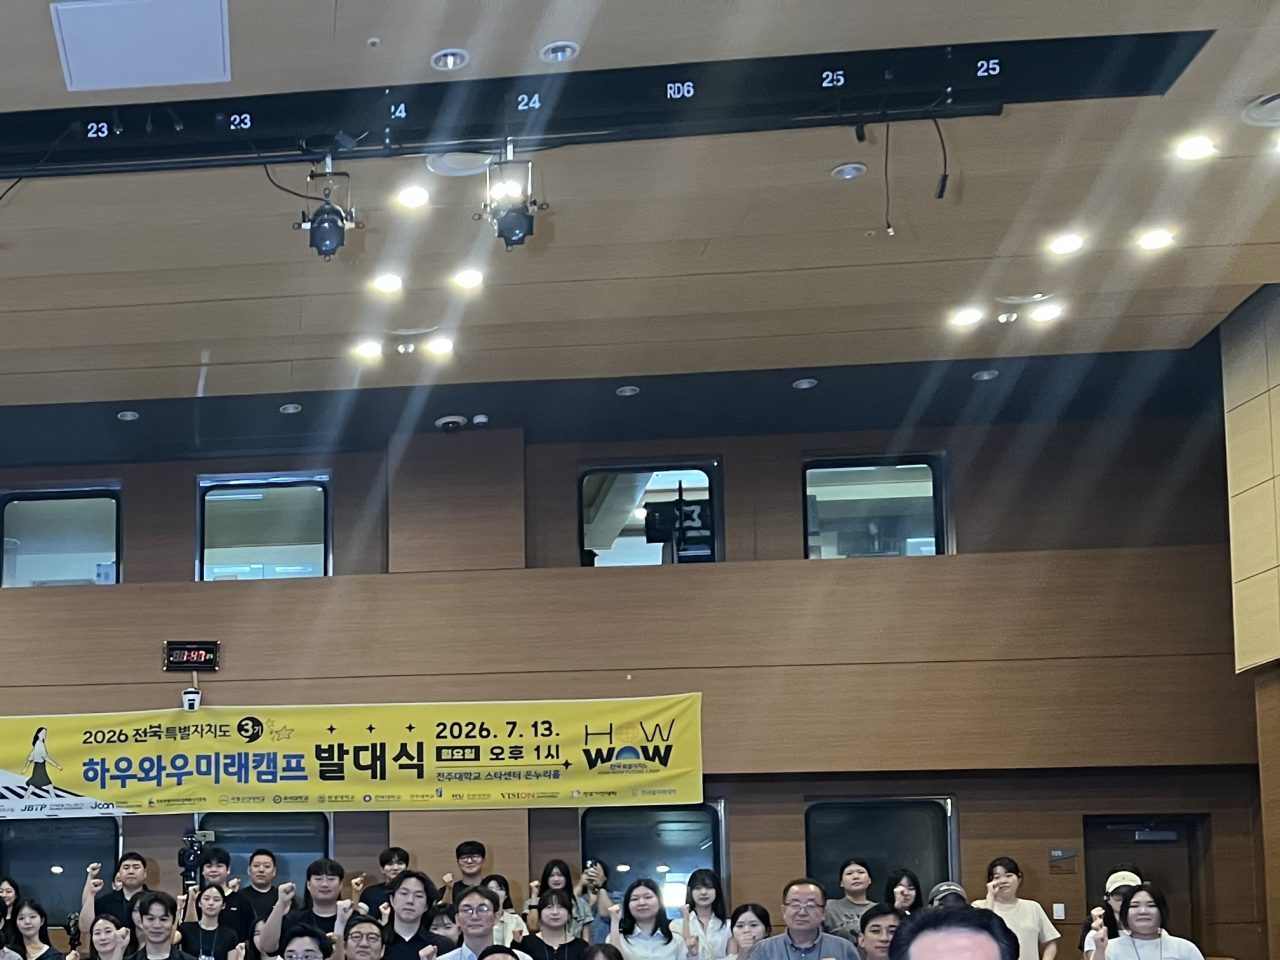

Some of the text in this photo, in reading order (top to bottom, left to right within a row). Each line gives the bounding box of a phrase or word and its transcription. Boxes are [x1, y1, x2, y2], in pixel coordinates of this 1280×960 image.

[977, 59, 1000, 77] 25
[822, 70, 845, 87] 25
[666, 81, 695, 99] RD6
[517, 93, 541, 111] 24
[87, 122, 109, 138] 23
[230, 113, 251, 130] 23
[82, 729, 129, 745] 2026
[132, 723, 232, 743] 전북특별자치도
[435, 720, 560, 740] 2026. 7. 13.
[489, 745, 524, 761] 오후
[533, 744, 560, 761] 1시
[82, 741, 425, 790] 하우와우미래캠프 발대식
[484, 770, 522, 781] 스타센터
